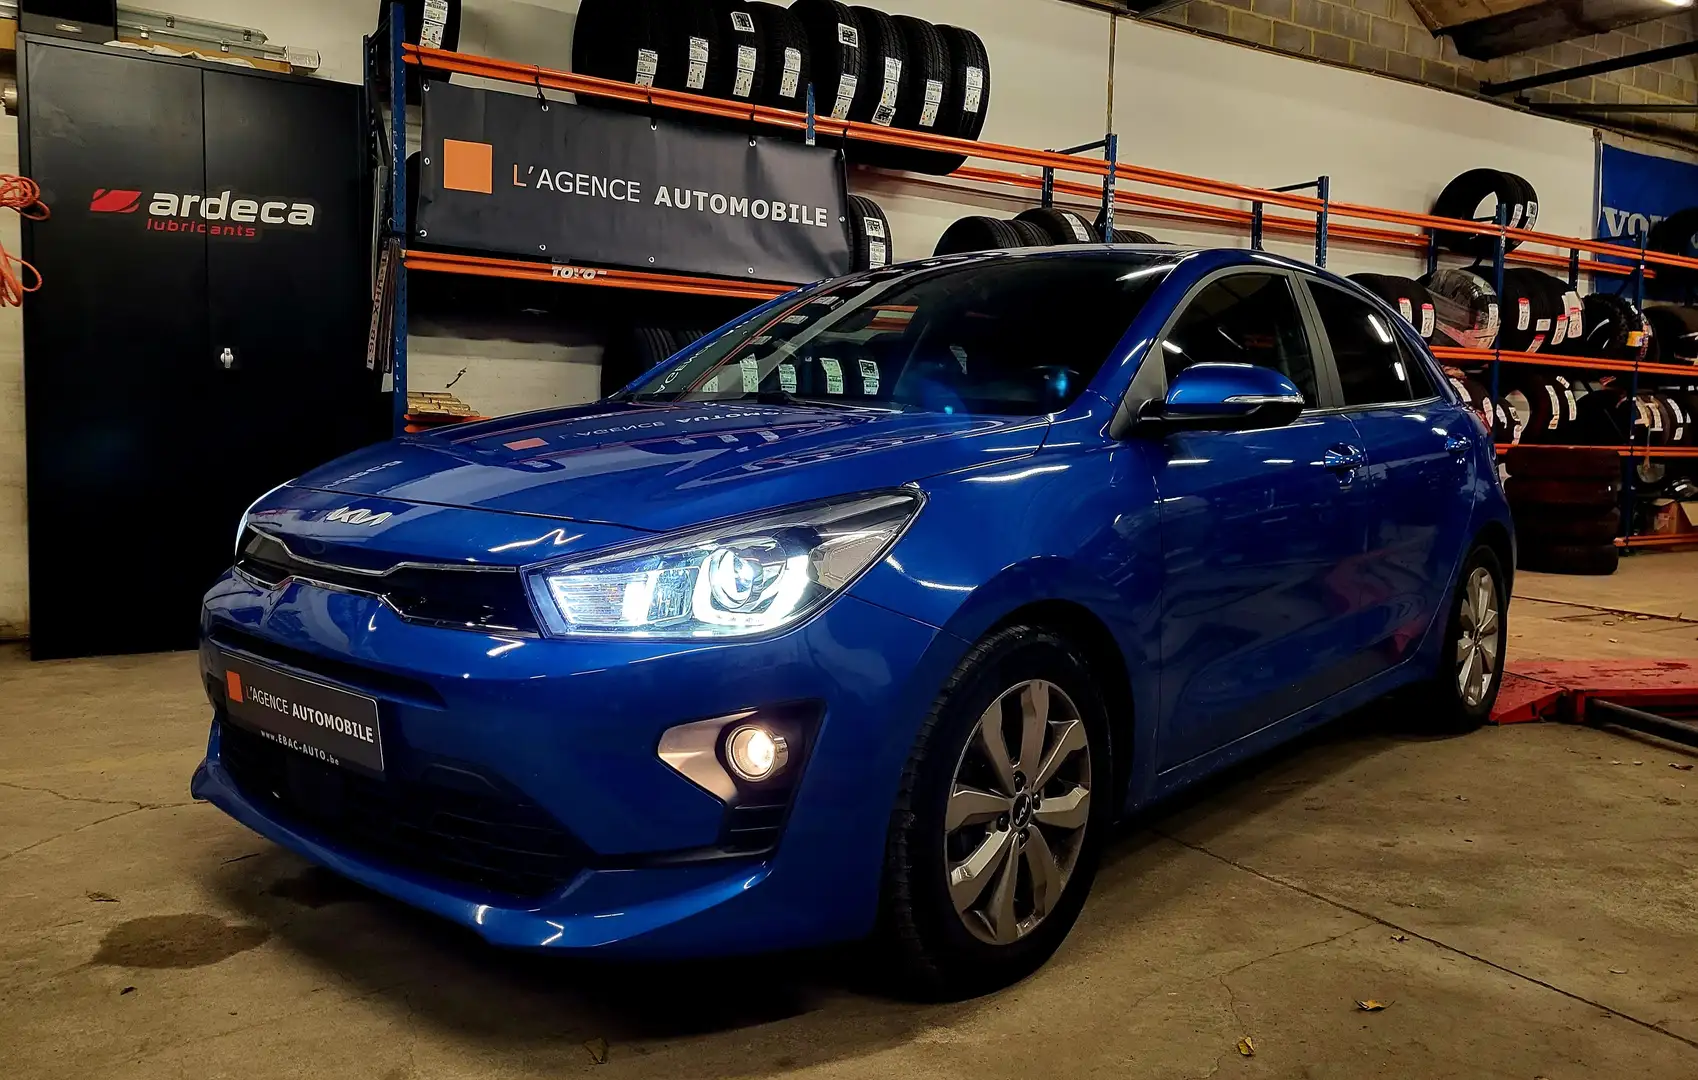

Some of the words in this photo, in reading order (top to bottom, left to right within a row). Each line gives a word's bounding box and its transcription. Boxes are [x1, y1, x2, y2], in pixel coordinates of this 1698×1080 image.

[148, 190, 316, 226] ardeca
[513, 163, 642, 203] L'AGENCE
[653, 185, 829, 228] AUTOMOBILE
[146, 218, 257, 238] lubricants
[245, 685, 289, 715] L'AGENCE
[292, 703, 374, 743] AUTOMOBILE
[260, 729, 340, 767] www.EBAC-AUTO.be
